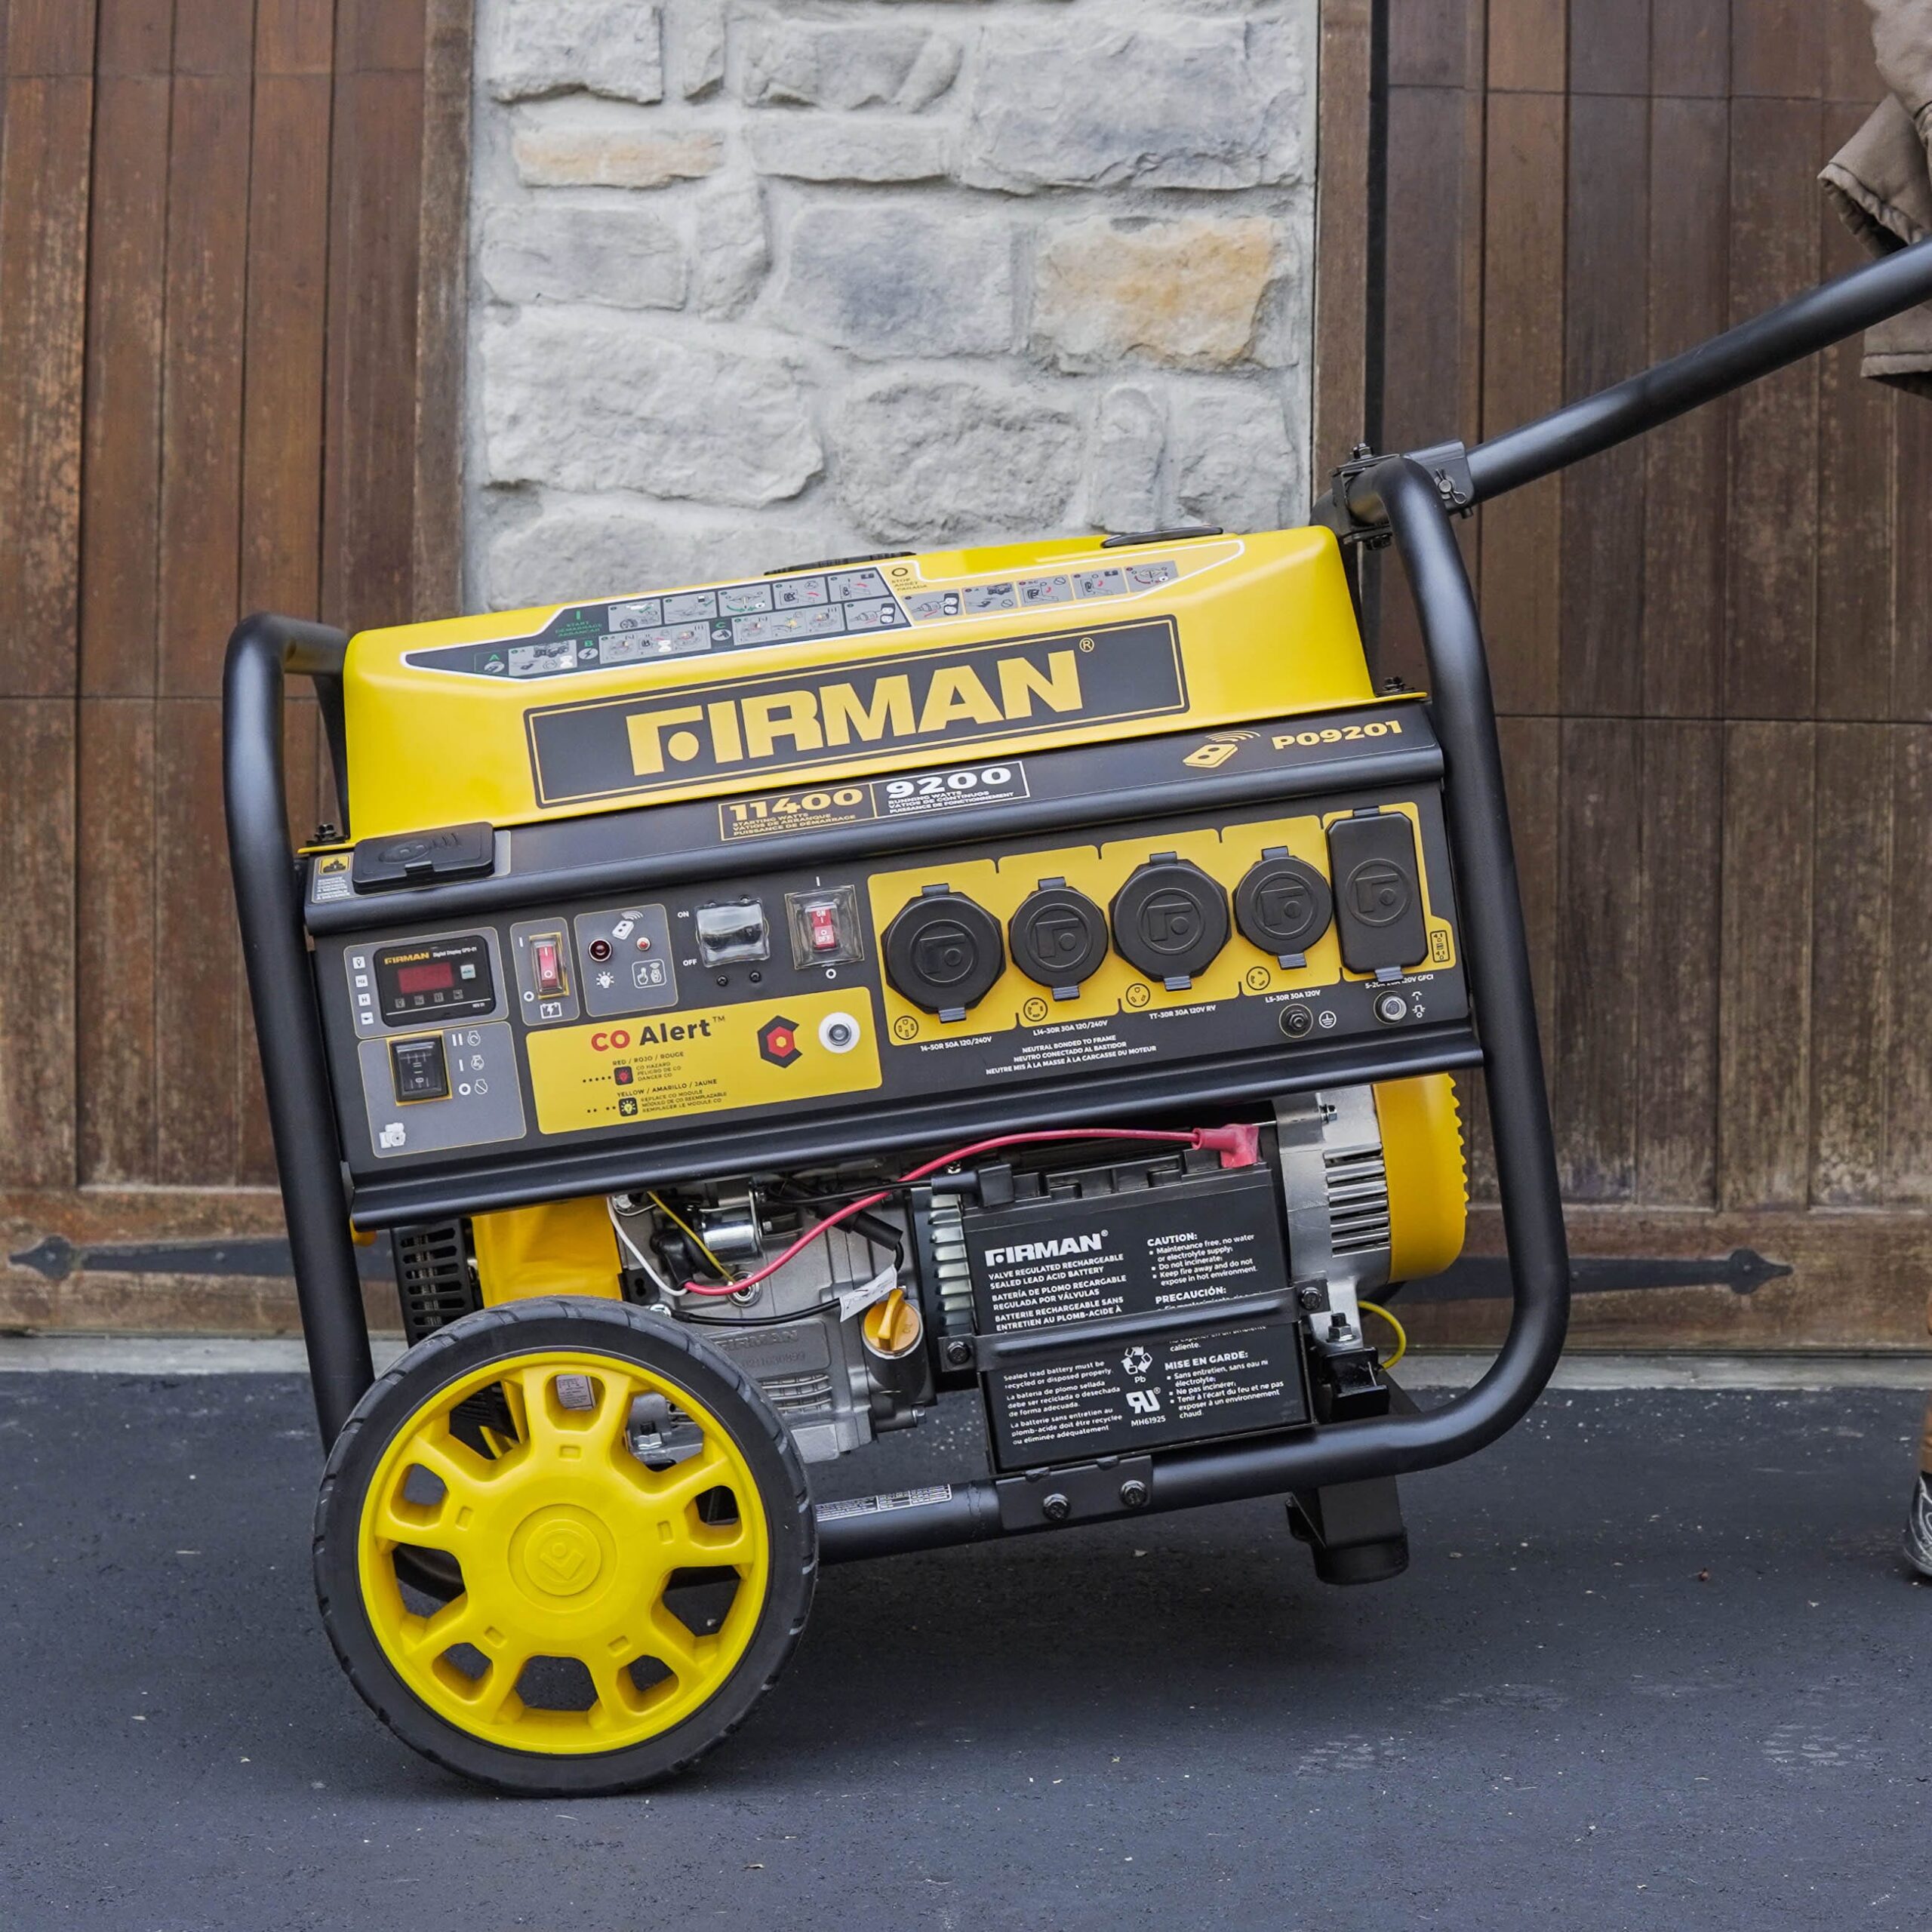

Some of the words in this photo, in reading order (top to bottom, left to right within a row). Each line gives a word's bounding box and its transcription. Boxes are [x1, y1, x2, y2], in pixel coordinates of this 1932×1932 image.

[1271, 720, 1402, 749] P09201
[886, 767, 1011, 798] 9200
[730, 789, 863, 821] 11400
[384, 952, 430, 965] FIRMAN
[1265, 994, 1289, 1003] L5-30R
[1149, 1010, 1173, 1020] TT-30R
[1033, 1026, 1060, 1036] L14-30R
[1075, 1020, 1108, 1030] 120/240V
[591, 1030, 631, 1051] CO
[920, 1042, 944, 1052] 14-50R
[959, 1036, 992, 1046] 120/240V
[1022, 1044, 1052, 1053] NEUTRAL
[1053, 1040, 1081, 1049] BONDED
[1093, 1035, 1116, 1043] FRAME
[986, 1066, 1012, 1075] NEUTRE
[1042, 1058, 1065, 1067] MASSE
[1081, 1051, 1116, 1061] CARCASSE
[1128, 1045, 1156, 1054] MOTEUR
[1013, 1054, 1041, 1063] NEUTRO
[1042, 1048, 1083, 1059] CONECTADO
[1094, 1042, 1126, 1052] BASTIDOR
[1147, 1232, 1197, 1246] CAUTION:
[1156, 1241, 1203, 1254] Maintenance
[1233, 1233, 1254, 1242] water
[1166, 1249, 1206, 1262] electrolyte
[988, 1270, 1013, 1280] VALVE
[1015, 1263, 1061, 1276] REGULATED
[1062, 1253, 1123, 1269] RECHARGEABLE
[1160, 1269, 1179, 1280] Keep
[1193, 1266, 1213, 1275] away
[1214, 1262, 1228, 1270] and
[990, 1278, 1021, 1289] SEALED
[1023, 1275, 1044, 1284] LEAD
[1045, 1272, 1066, 1281] ACID
[1068, 1266, 1104, 1278] BATTERY
[992, 1288, 1027, 1301] BATERÍA
[1041, 1283, 1071, 1294] PLOMO
[1072, 1275, 1126, 1289] RECARGABLE
[1160, 1277, 1187, 1287] expose
[993, 1297, 1037, 1310] REGULADA
[1038, 1295, 1056, 1303] POR
[1057, 1287, 1099, 1301] VÁLVULAS
[1155, 1285, 1226, 1304] PRECAUCIÓN:
[995, 1310, 1033, 1322] BATTERIE
[1035, 1300, 1099, 1316] RECHARGEABLE
[1101, 1296, 1123, 1306] SANS
[996, 1318, 1041, 1331] ENTRETIEN
[1056, 1307, 1113, 1322] PLOMB-ACIDE
[1164, 1359, 1190, 1370] MISE
[1192, 1357, 1207, 1366] EN
[1208, 1351, 1248, 1364] GARDE:
[1178, 1402, 1207, 1412] exposer
[1225, 1389, 1279, 1403] environnement
[1131, 1415, 1166, 1426] MH61925
